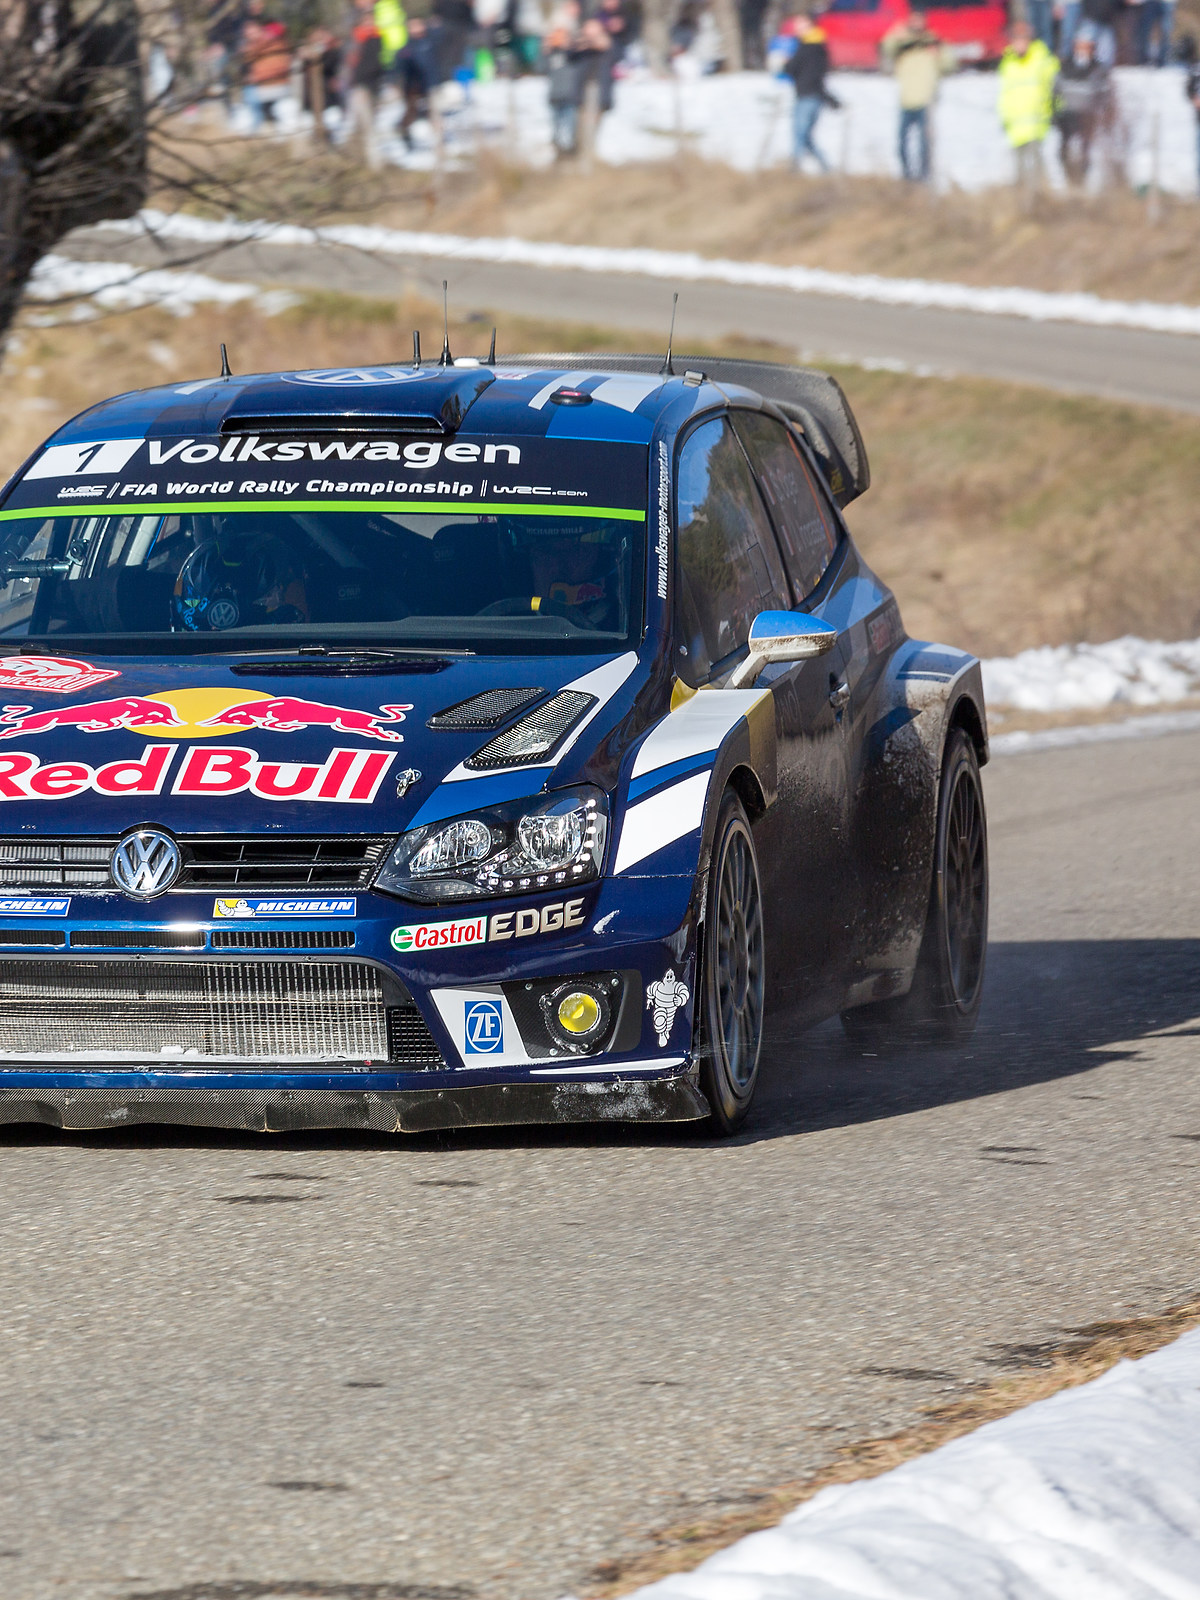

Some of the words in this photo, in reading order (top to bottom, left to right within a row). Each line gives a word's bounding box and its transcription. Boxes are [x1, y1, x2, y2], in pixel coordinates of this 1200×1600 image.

[75, 443, 106, 473] 1
[149, 437, 521, 469] Volkswagen
[120, 483, 157, 496] FIA
[166, 480, 234, 495] World
[239, 481, 300, 495] Rally
[305, 479, 474, 497] Championship
[178, 748, 387, 800] Bull
[256, 901, 353, 911] MICHELIN
[415, 920, 482, 948] Castrol
[489, 897, 586, 942] EDGE
[469, 1012, 500, 1042] ZF
